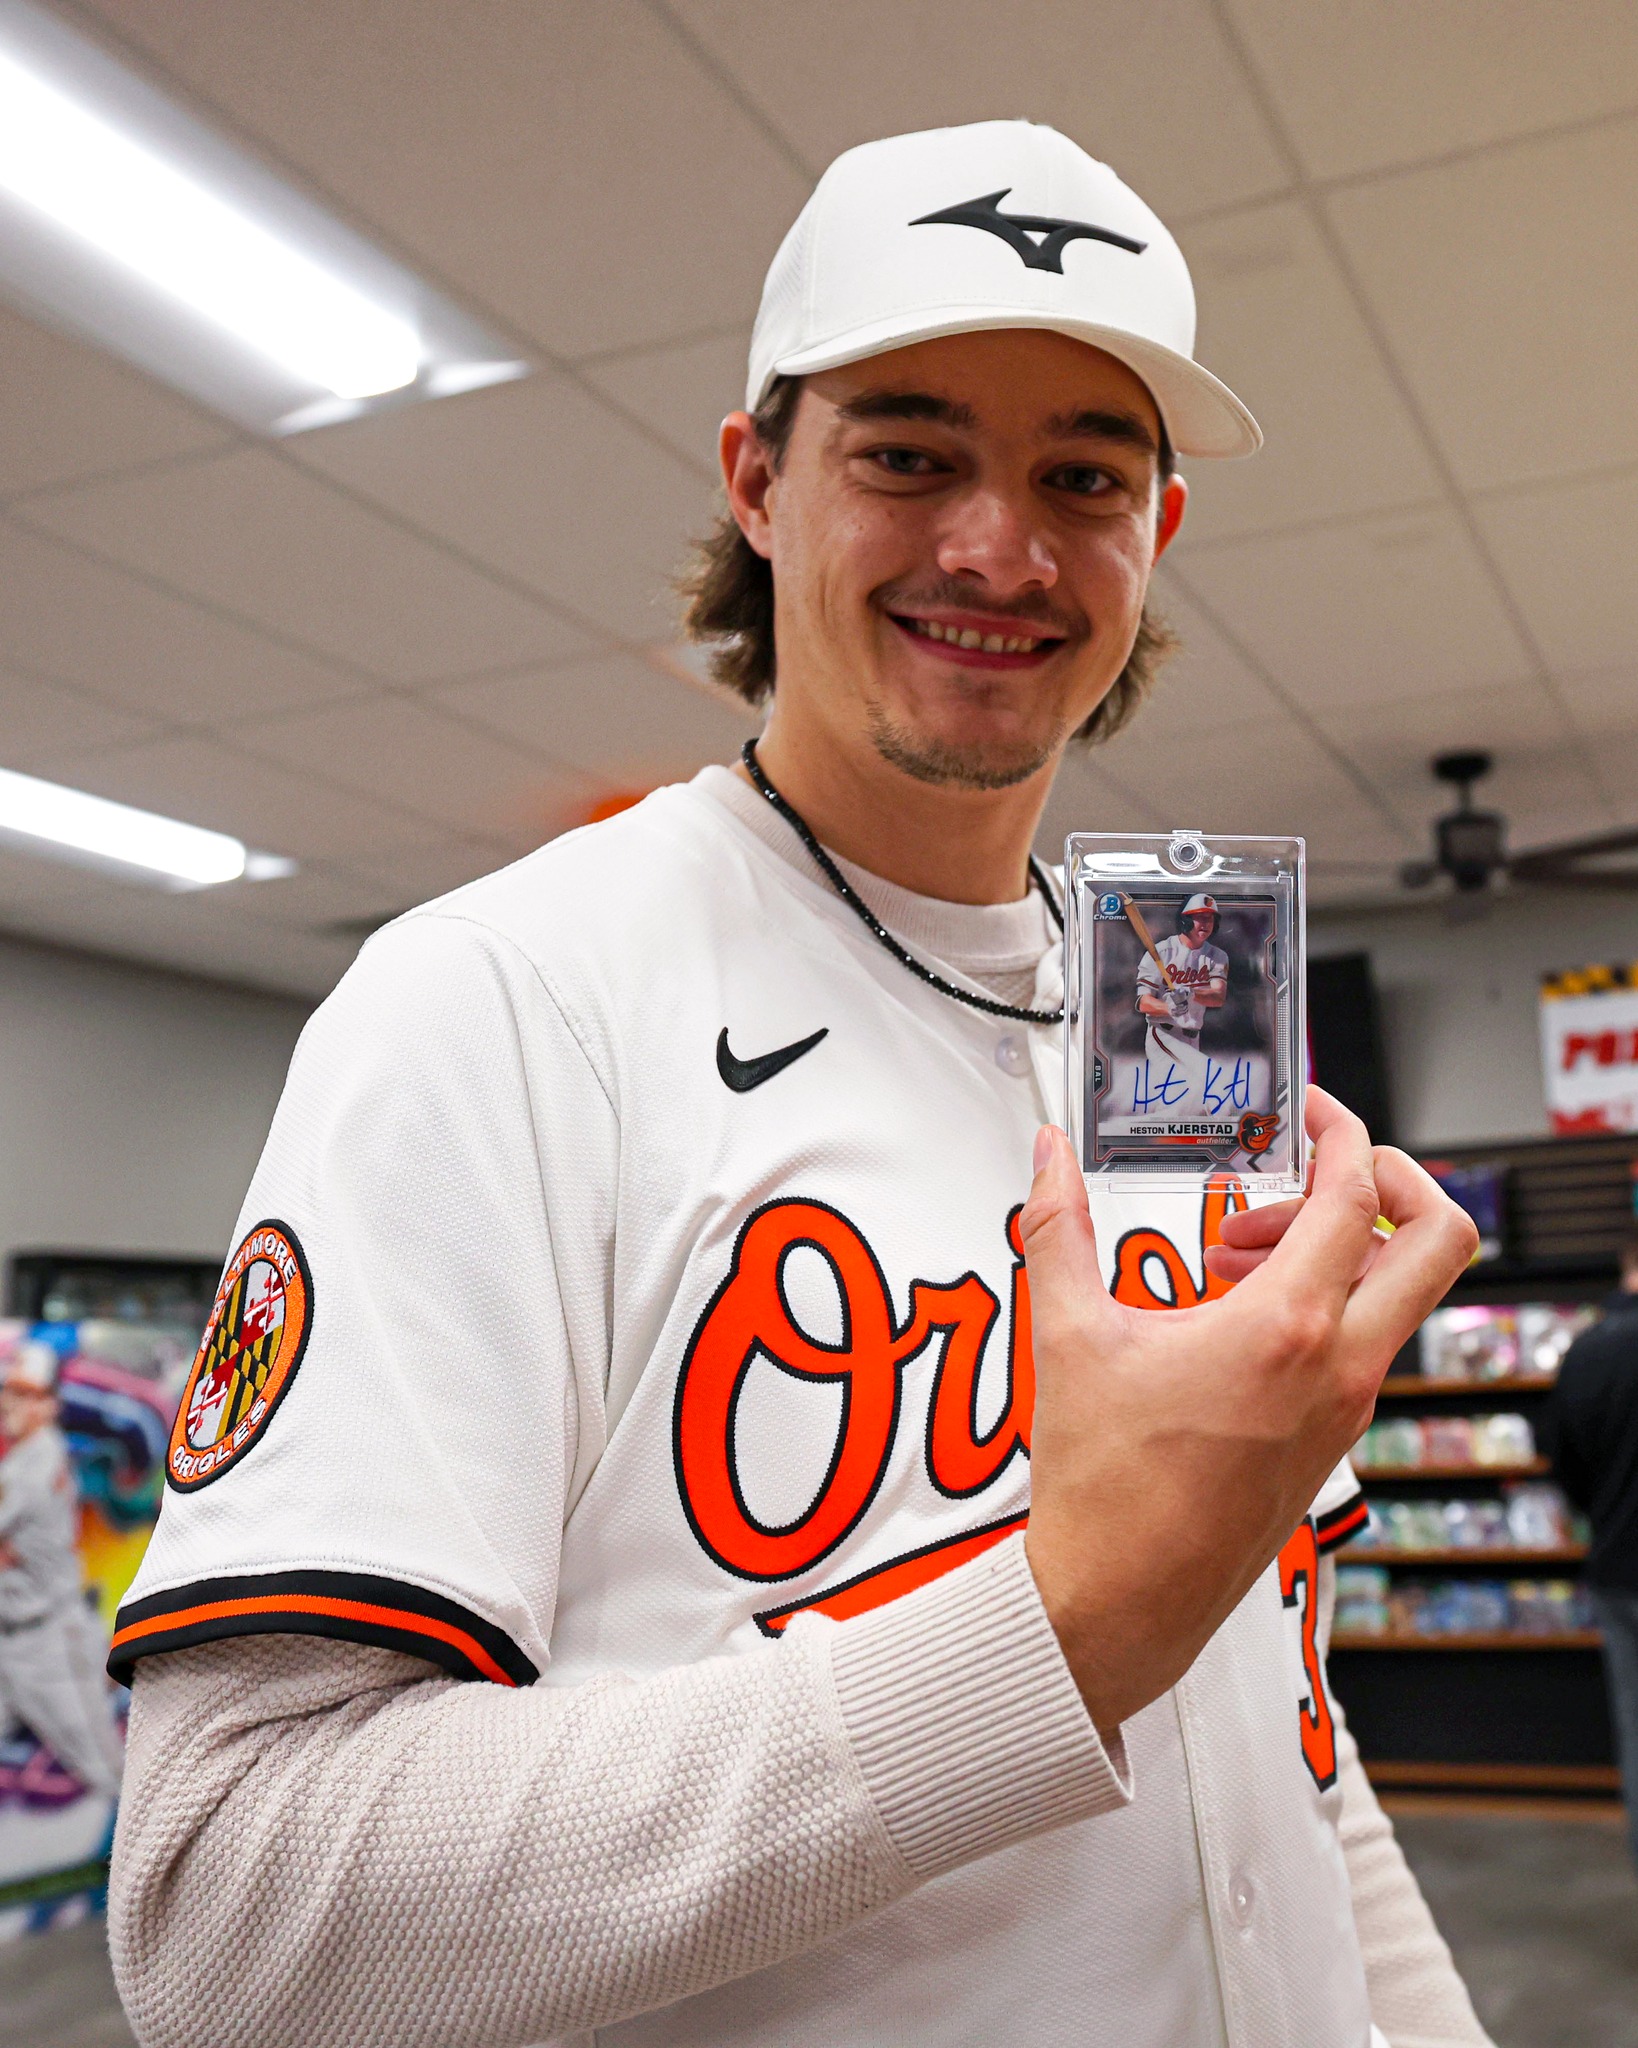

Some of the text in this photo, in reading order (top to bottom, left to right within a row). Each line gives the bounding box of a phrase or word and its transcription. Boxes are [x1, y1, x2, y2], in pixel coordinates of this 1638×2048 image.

[1093, 913, 1128, 921] Chrome
[1094, 1065, 1102, 1082] BAL
[1130, 1124, 1233, 1135] HESTON KJERSTAD
[1196, 1137, 1233, 1145] outfielder
[200, 1233, 297, 1352] BALTIMORE
[172, 1398, 267, 1478] ORIOLES
